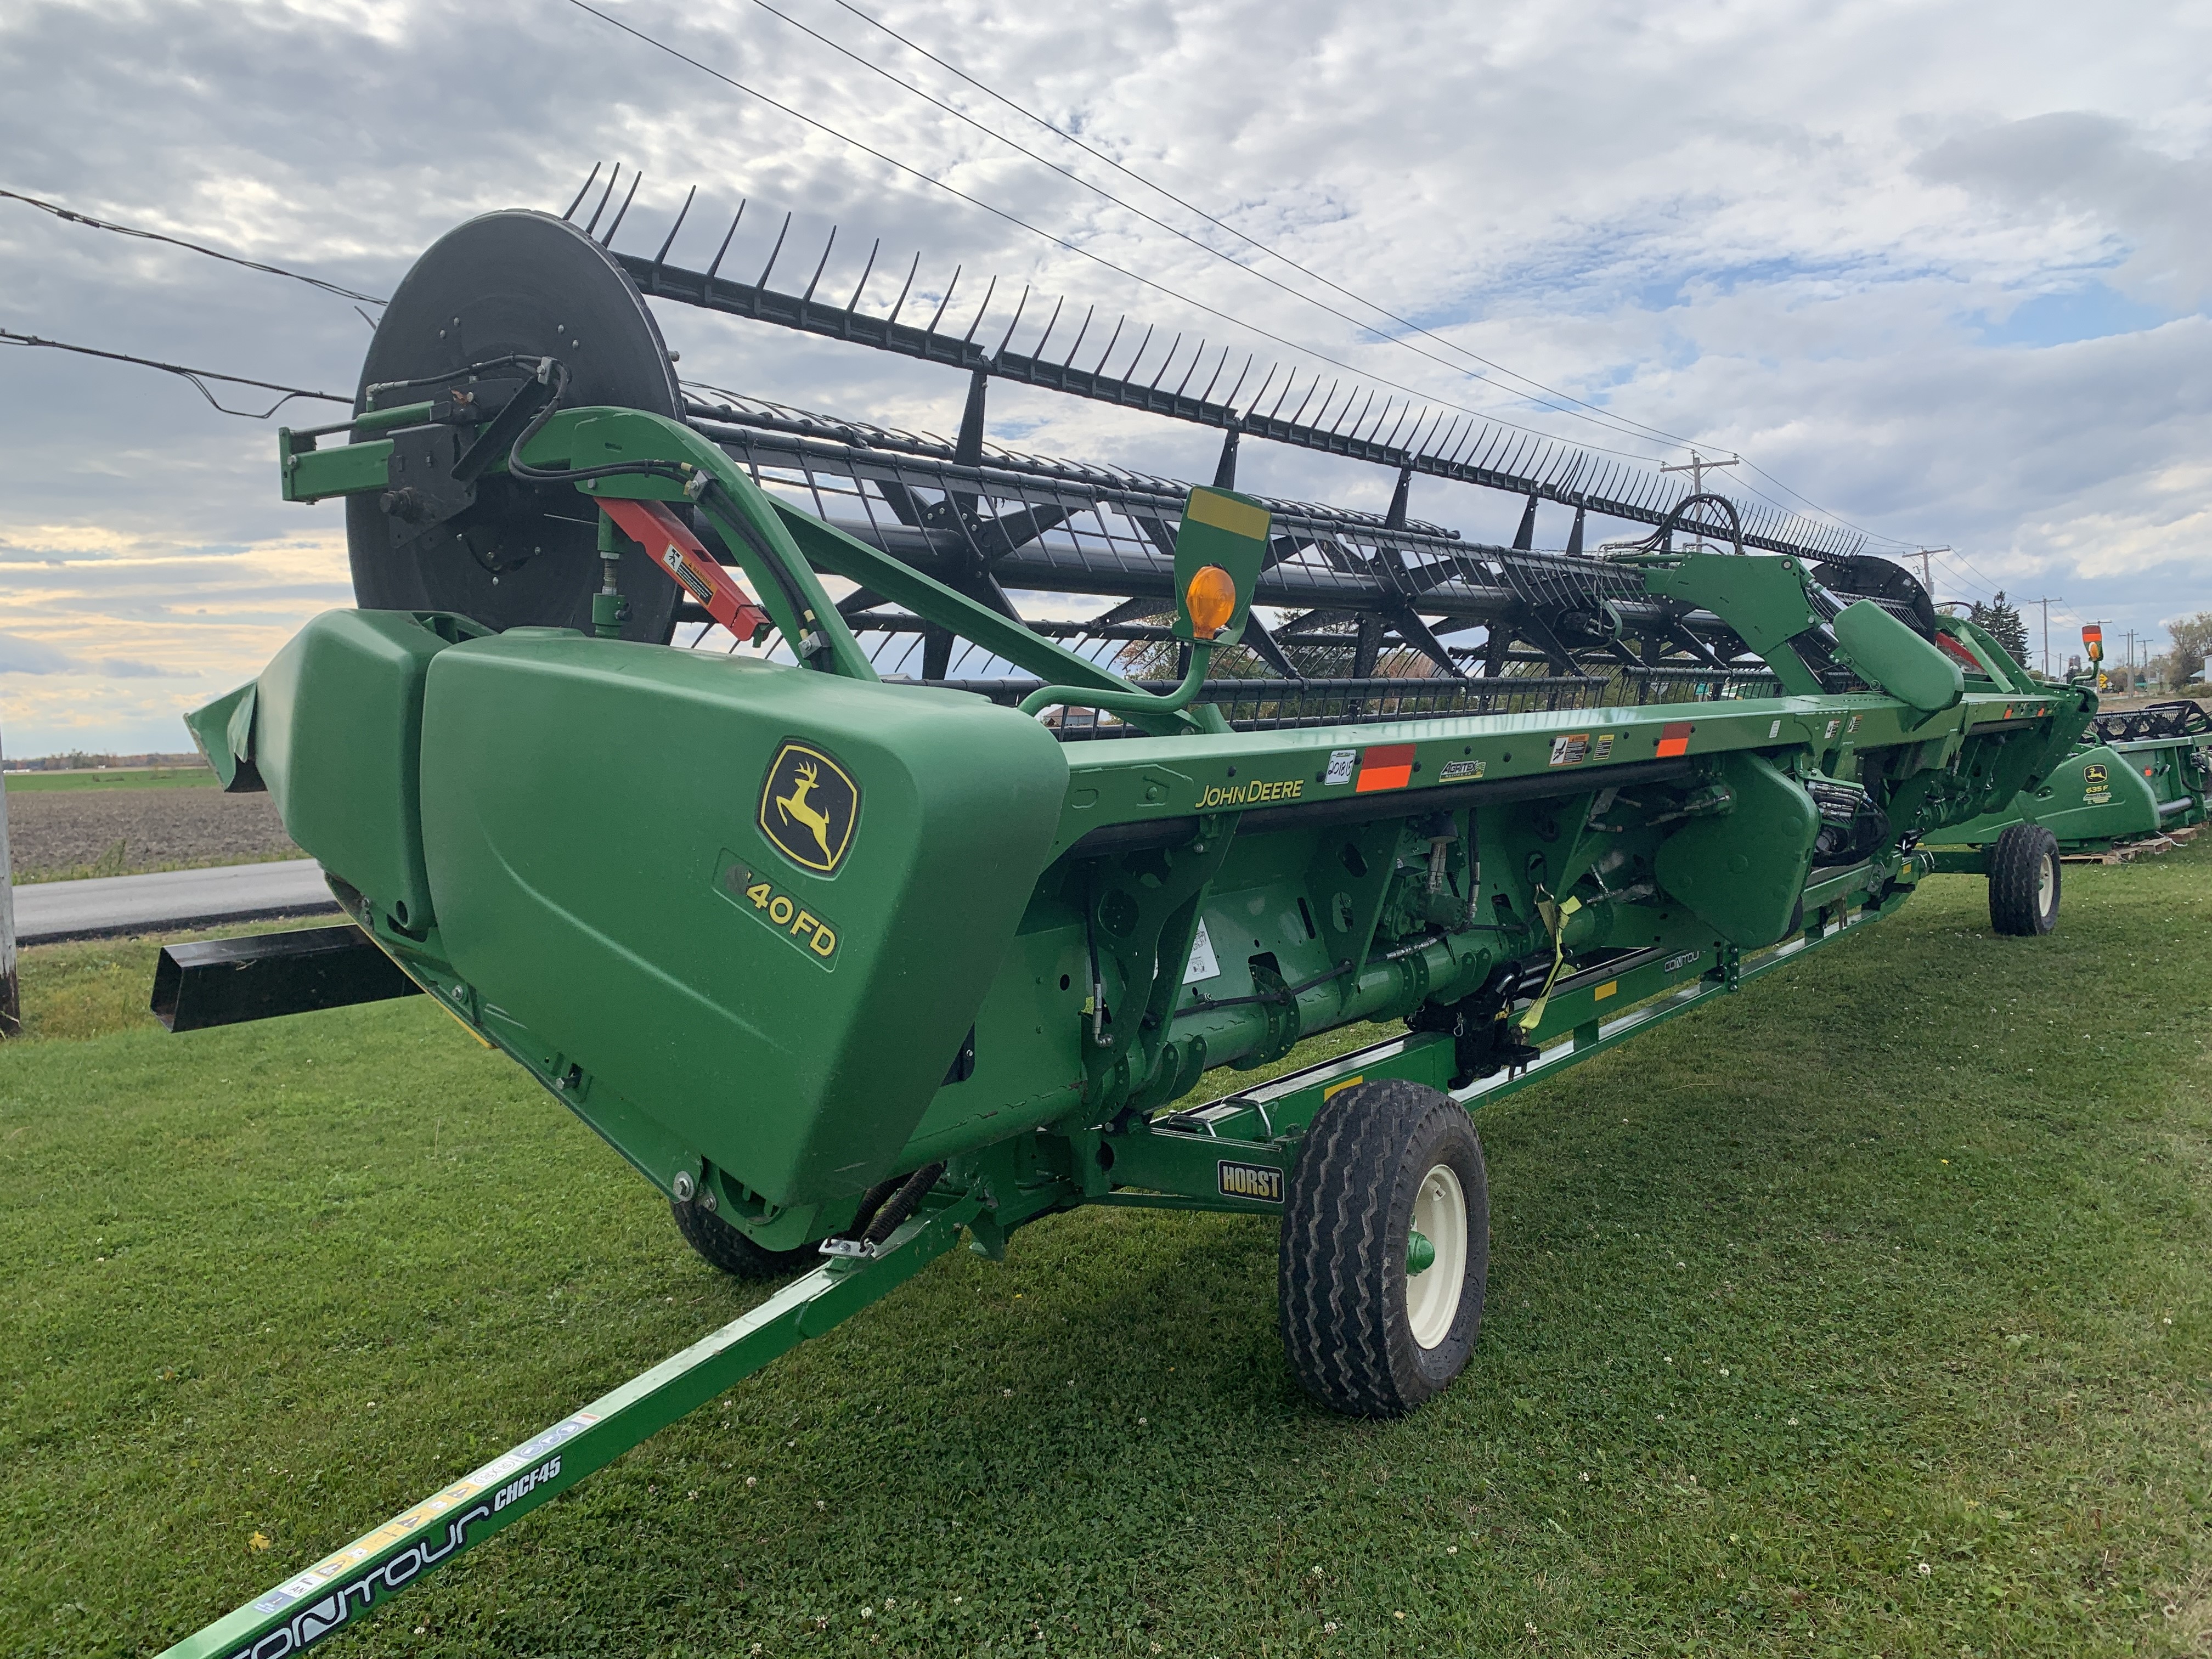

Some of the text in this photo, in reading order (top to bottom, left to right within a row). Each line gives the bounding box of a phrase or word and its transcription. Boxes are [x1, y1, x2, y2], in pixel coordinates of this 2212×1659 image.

[693, 566, 712, 587] WARNING
[1441, 761, 1478, 774] AGRITEX
[1195, 780, 1304, 808] JOHN DEERE
[1664, 950, 1706, 973] CONTOU
[1222, 1165, 1280, 1198] HORST
[494, 1455, 562, 1512] CHCF45
